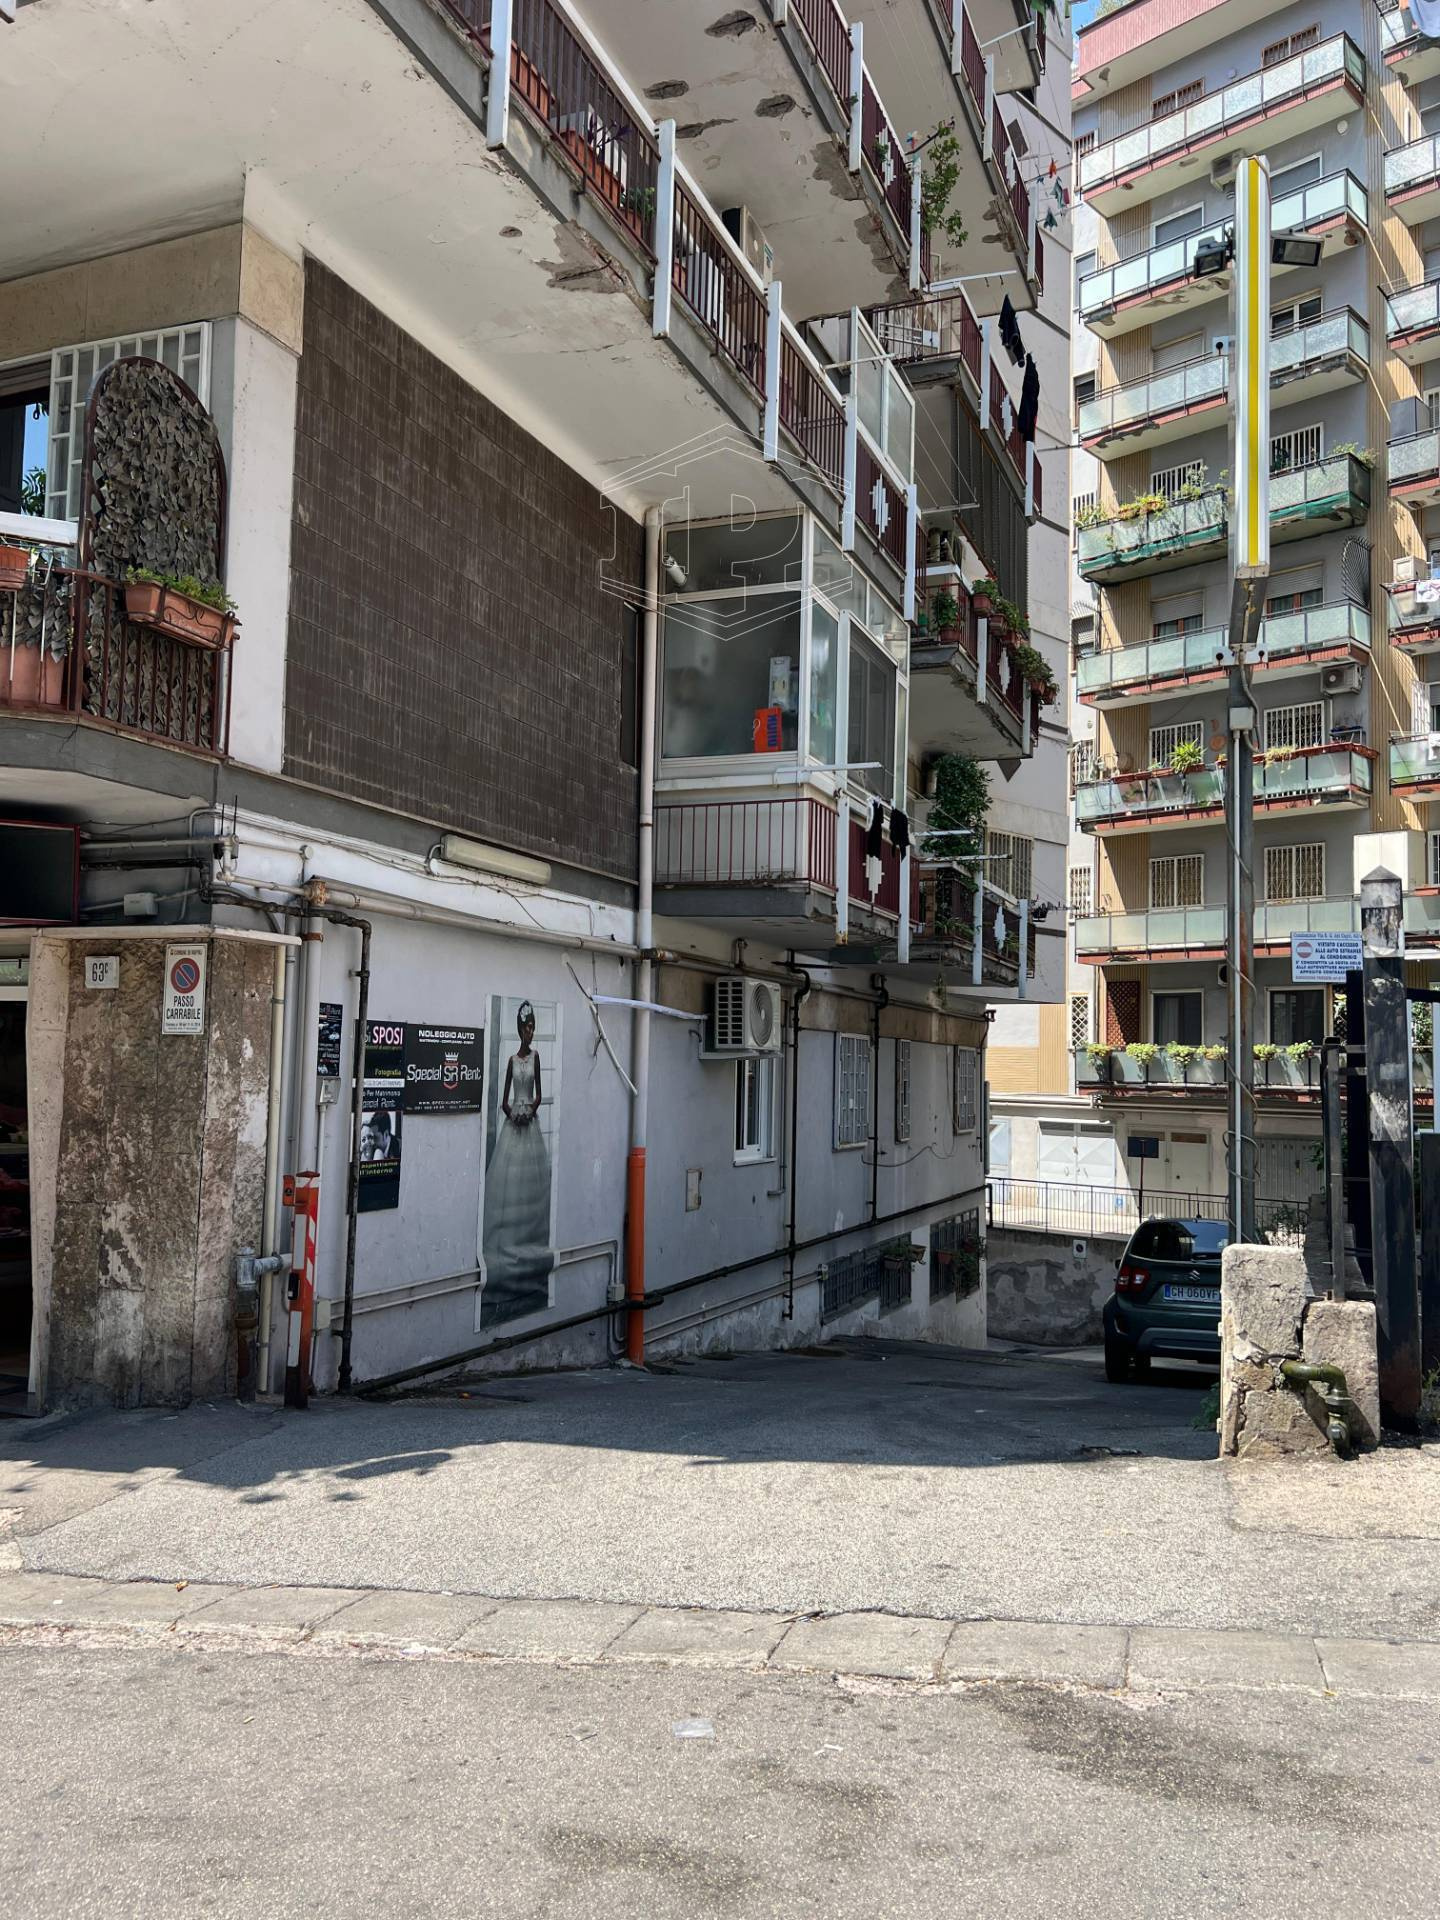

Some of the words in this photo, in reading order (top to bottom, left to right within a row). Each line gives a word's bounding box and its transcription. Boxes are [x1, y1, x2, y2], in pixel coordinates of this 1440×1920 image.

[174, 996, 194, 1007] PASSO
[166, 1008, 200, 1020] CARRABILE
[372, 1026, 403, 1045] SPOSI
[418, 1030, 456, 1038] NOLEGGIO
[457, 1032, 475, 1040] AUTO
[406, 1064, 442, 1083] Special
[460, 1064, 482, 1081] Rent
